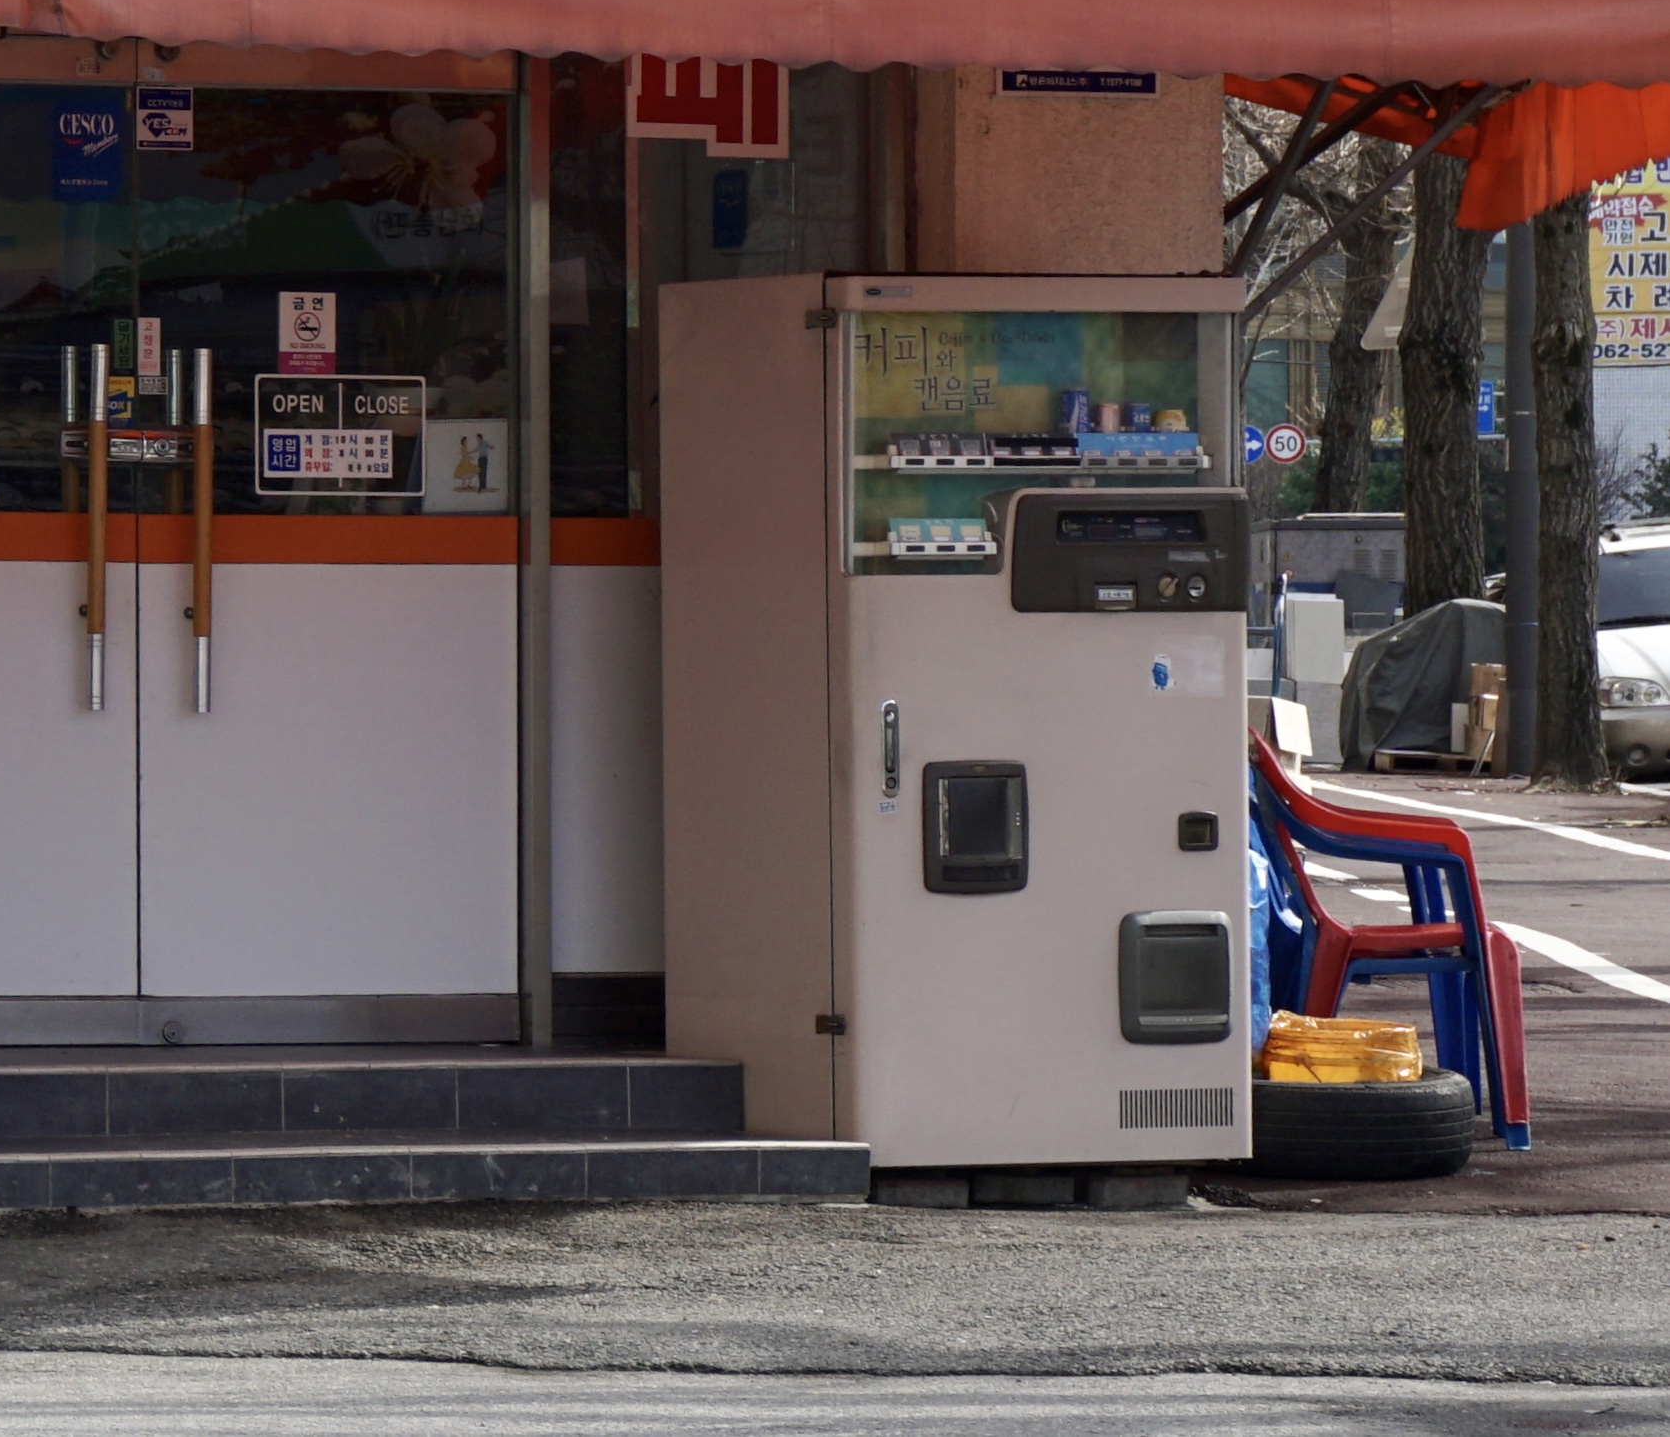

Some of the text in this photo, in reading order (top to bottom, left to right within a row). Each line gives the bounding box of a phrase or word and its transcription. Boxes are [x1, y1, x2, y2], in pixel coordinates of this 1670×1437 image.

[59, 113, 115, 136] CESCO
[855, 326, 927, 376] 커피
[934, 349, 957, 371] 와
[913, 374, 995, 411] 캔음료
[272, 393, 410, 415] OPEN CLOSE
[271, 438, 297, 452] 영업
[1274, 435, 1297, 454] 50
[271, 454, 297, 469] 시간
